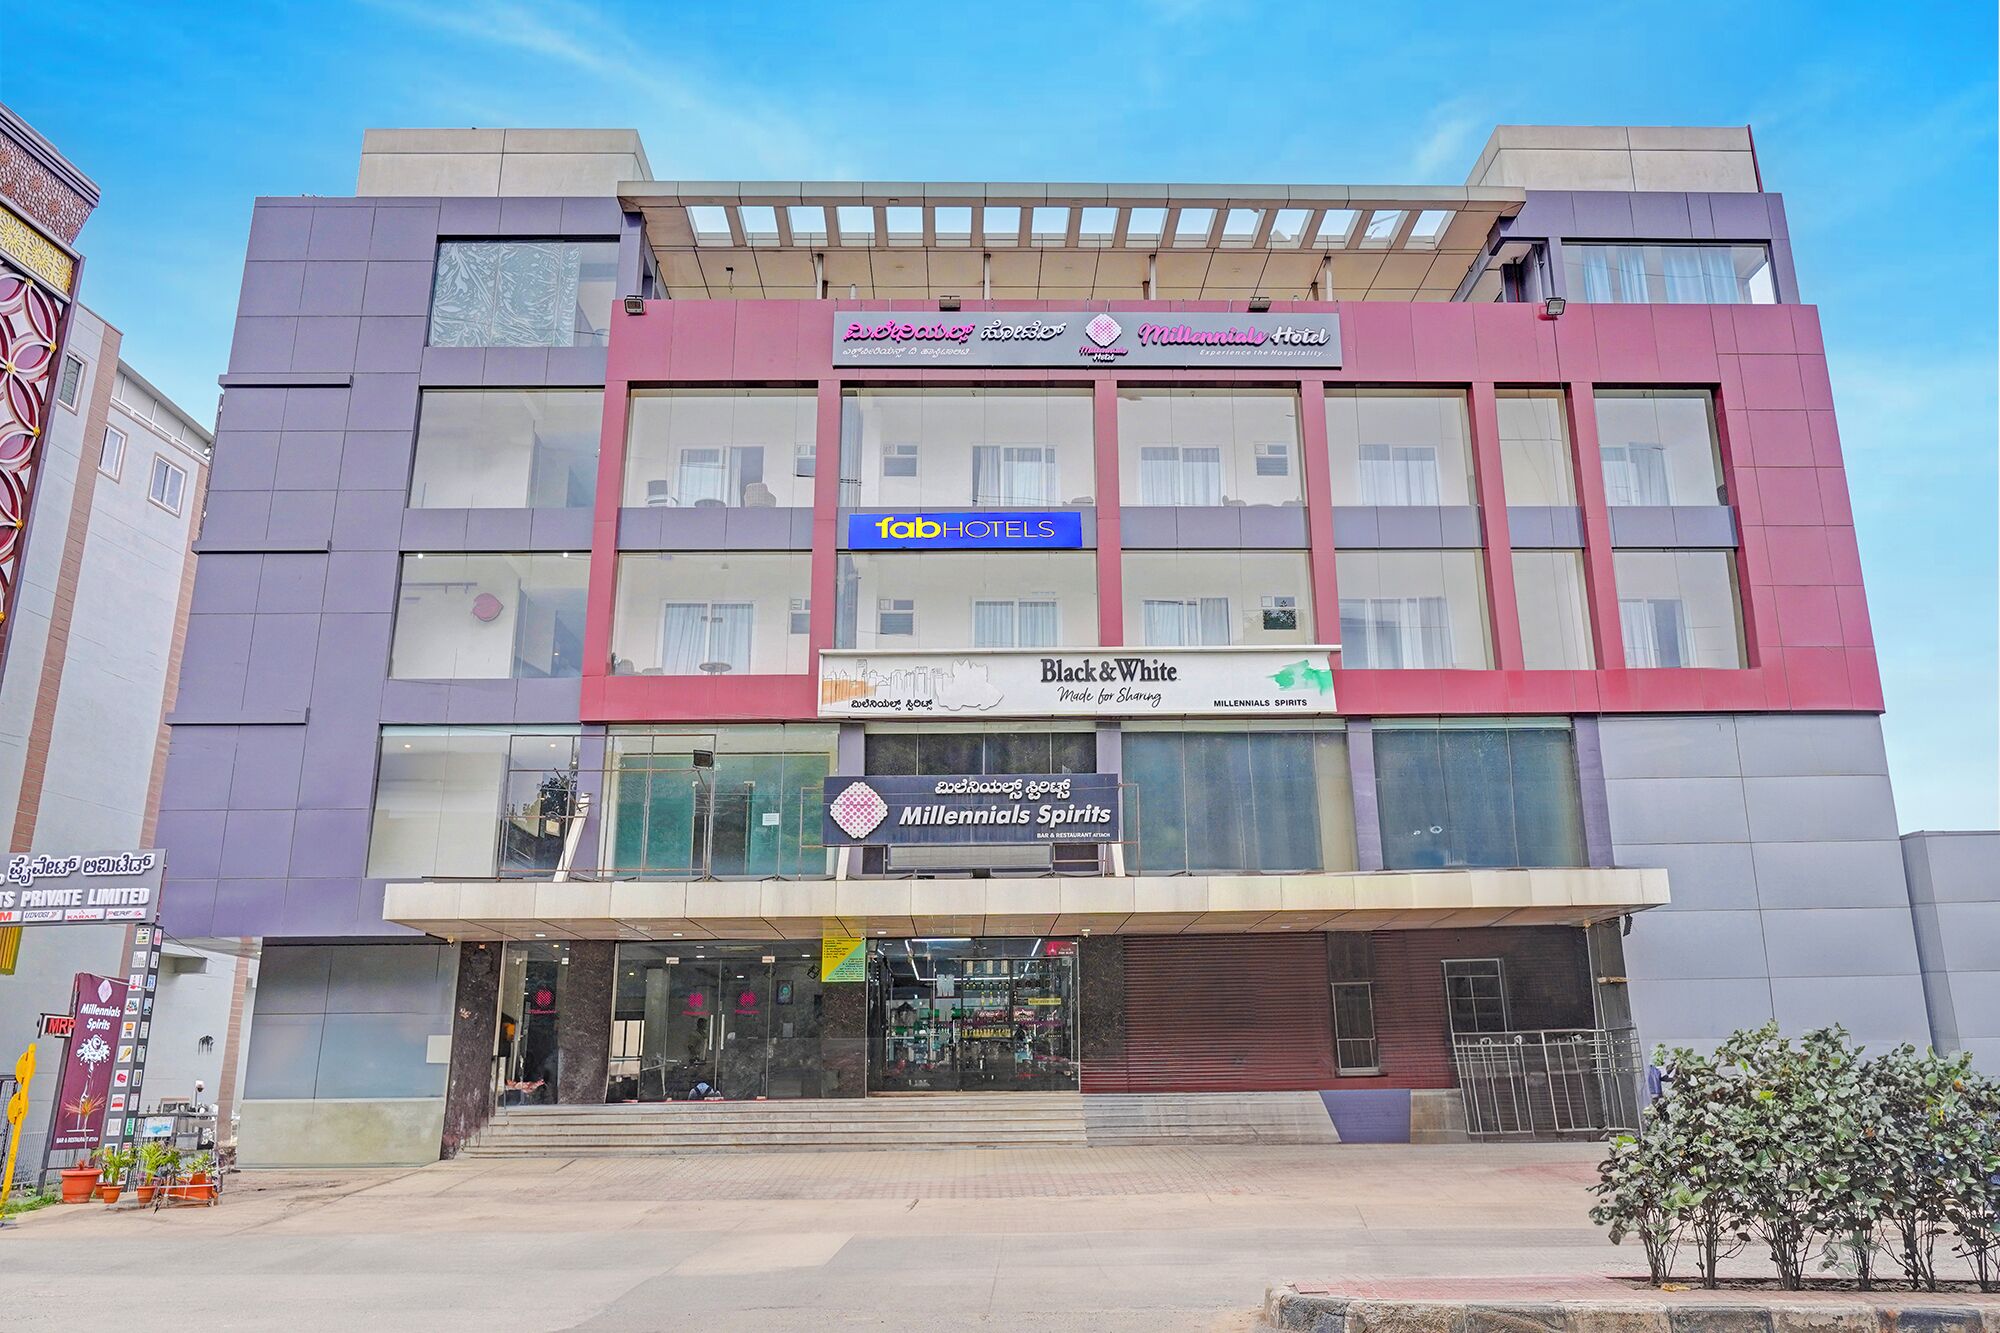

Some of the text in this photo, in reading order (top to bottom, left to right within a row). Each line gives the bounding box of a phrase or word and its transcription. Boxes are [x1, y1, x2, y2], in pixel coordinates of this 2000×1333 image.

[980, 319, 1067, 341] ಹೋಟೆಲ್
[1138, 322, 1331, 345] Millennials Hotel
[1199, 349, 1253, 357] Experience
[1057, 686, 1162, 708] Made for Sharing
[1213, 699, 1308, 707] MILLENNIALS SPIRITS
[899, 804, 1111, 829] Millennials Spirits
[20, 889, 83, 908] PRIVATE
[87, 887, 150, 906] LIMITED
[80, 1003, 121, 1018] Millennials
[48, 1018, 76, 1035] MRP
[87, 1018, 111, 1031] Spirits
